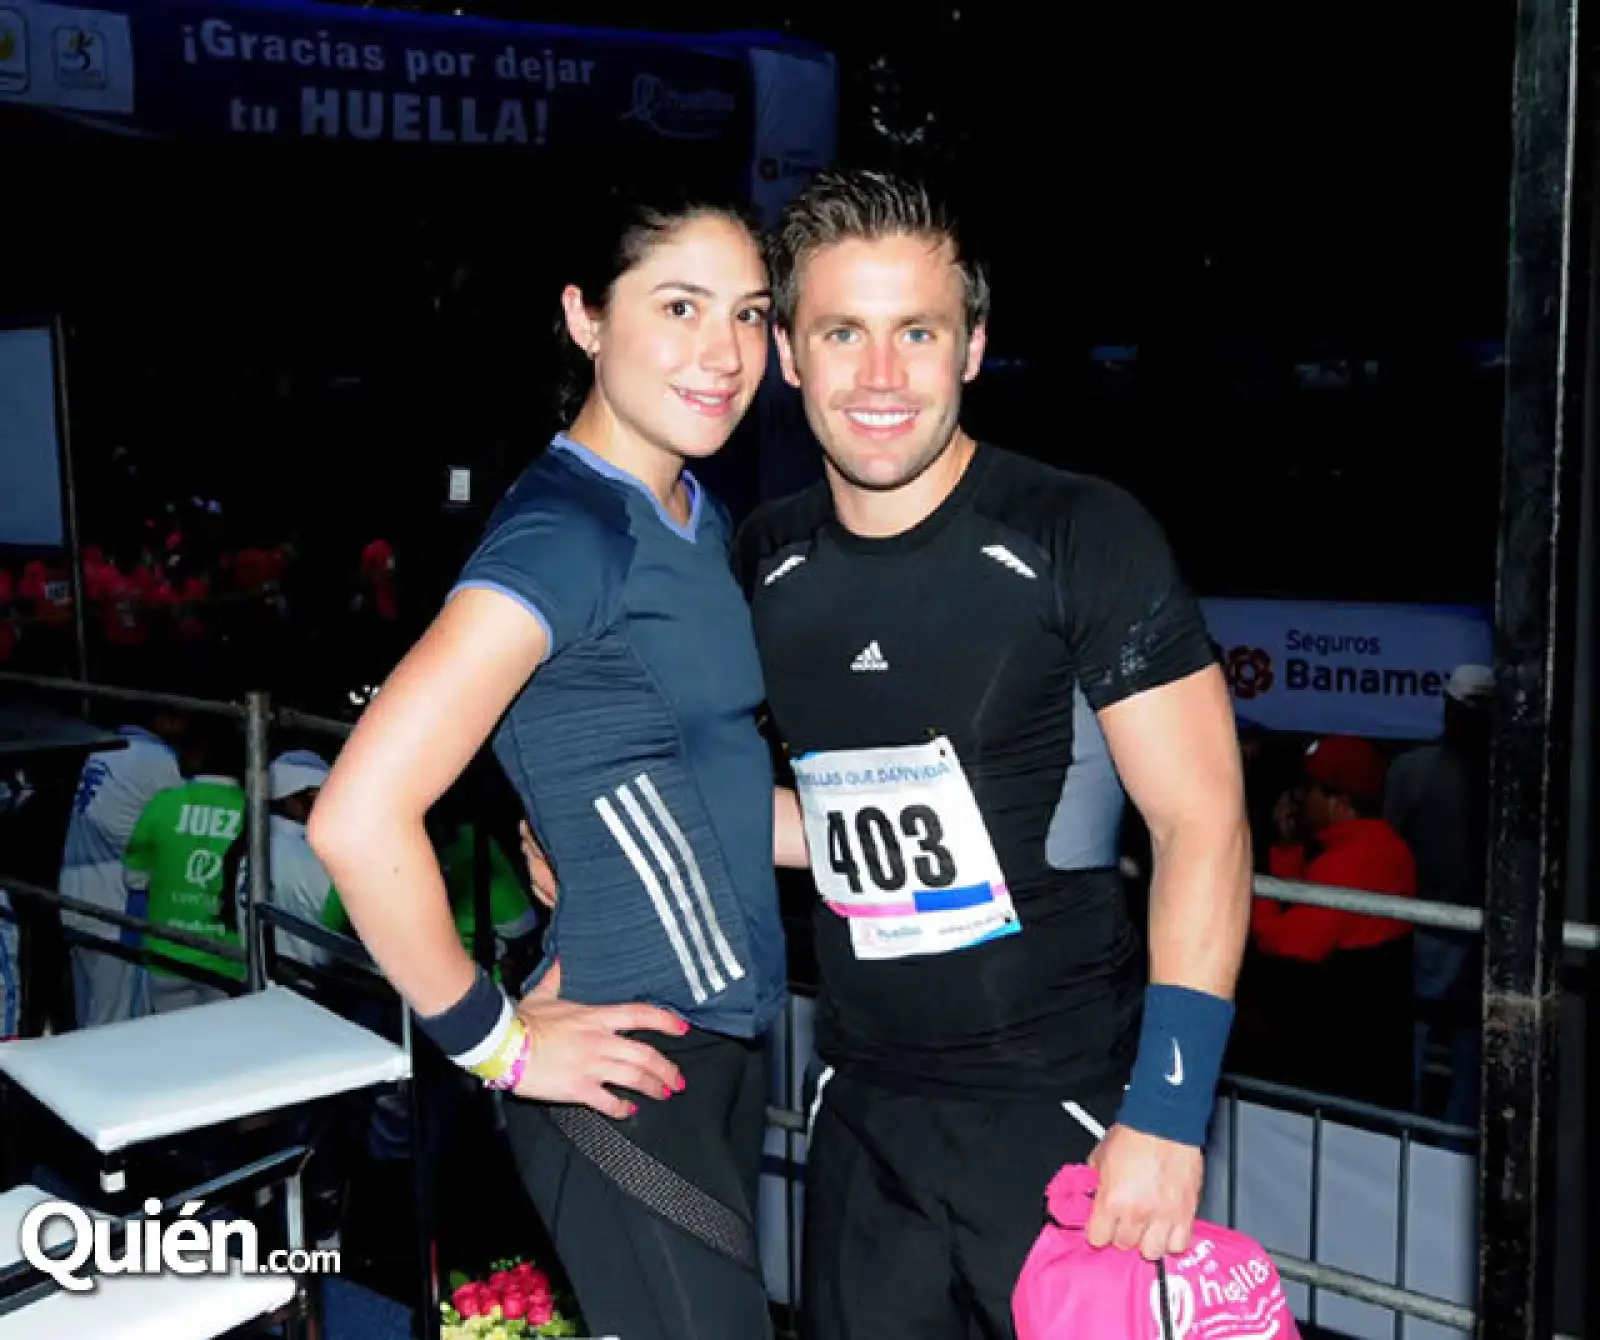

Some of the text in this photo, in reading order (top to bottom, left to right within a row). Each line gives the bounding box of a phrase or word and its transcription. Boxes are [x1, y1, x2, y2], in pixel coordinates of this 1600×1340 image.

[180, 16, 597, 93] ¡Gracias por dejar
[229, 86, 549, 146] tu HUELLA!
[1286, 629, 1382, 656] Seguros
[175, 804, 241, 840] JUEZ
[827, 804, 957, 894] 403
